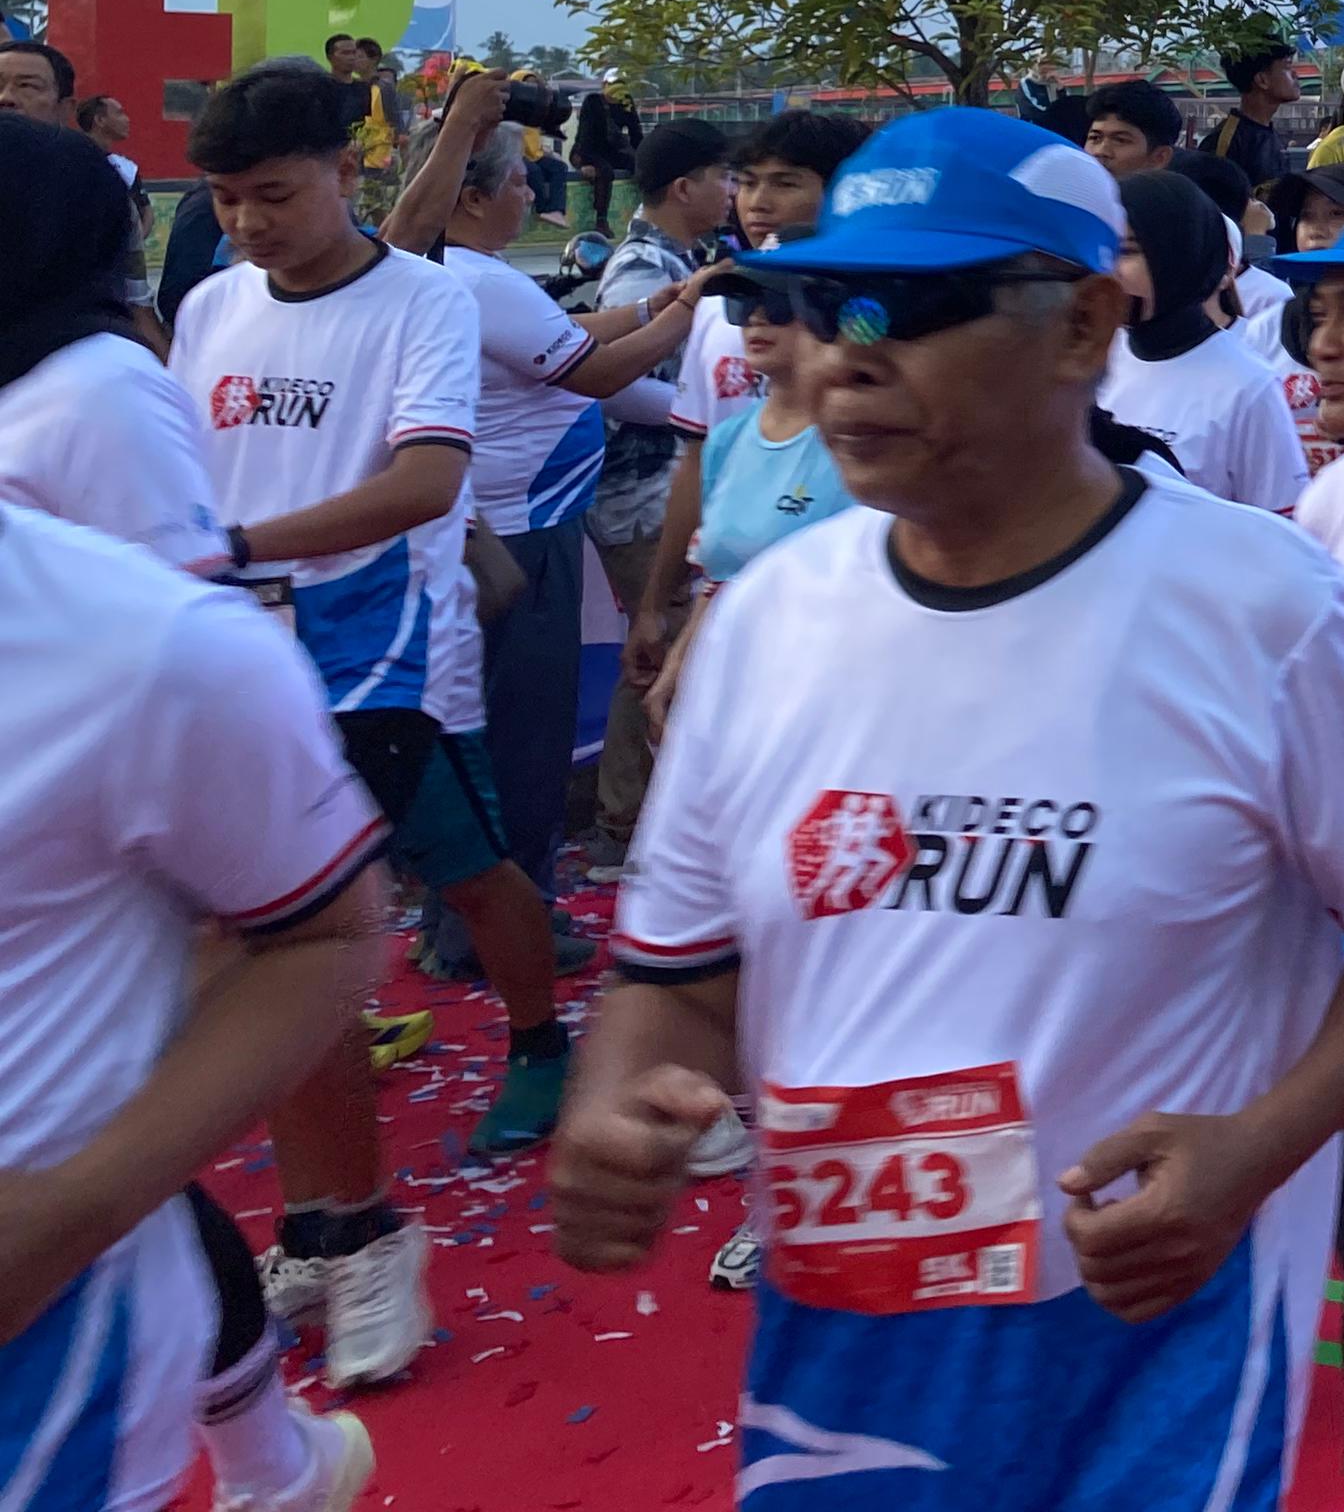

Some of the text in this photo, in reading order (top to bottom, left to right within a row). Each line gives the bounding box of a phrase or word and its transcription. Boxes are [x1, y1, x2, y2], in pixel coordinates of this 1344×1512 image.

[248, 393, 330, 428] RUN
[911, 794, 1099, 839] KIDECO
[884, 834, 1097, 918] RUN
